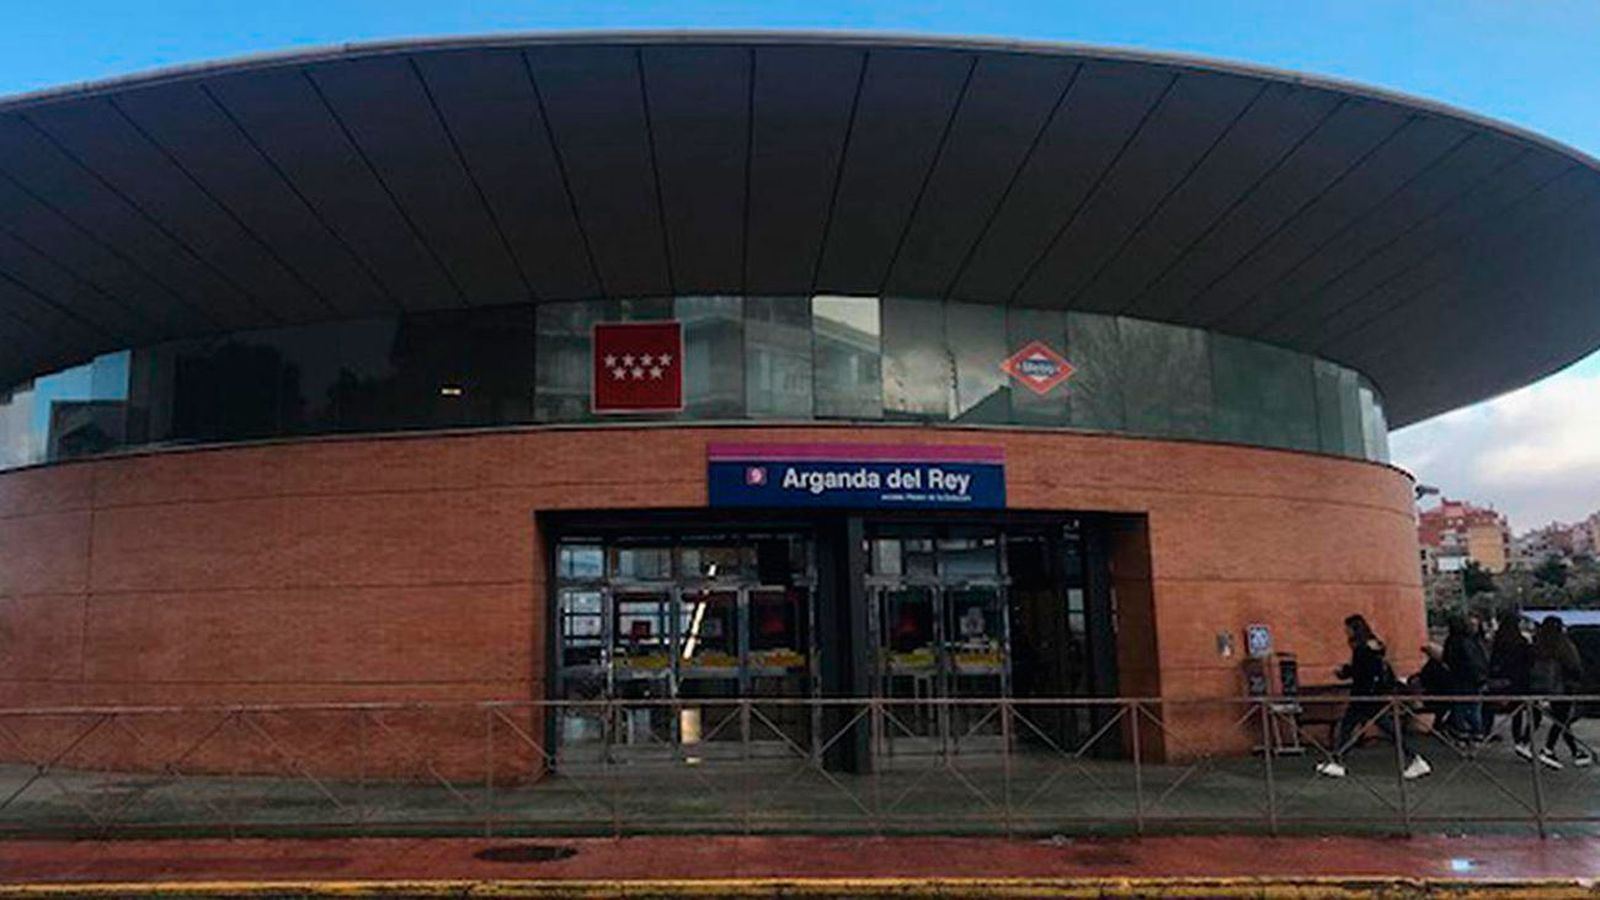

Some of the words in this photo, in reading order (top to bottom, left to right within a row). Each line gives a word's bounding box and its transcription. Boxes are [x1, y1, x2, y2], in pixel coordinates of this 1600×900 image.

[782, 467, 880, 494] Arganda
[886, 468, 921, 489] del
[928, 468, 971, 495] Rey
